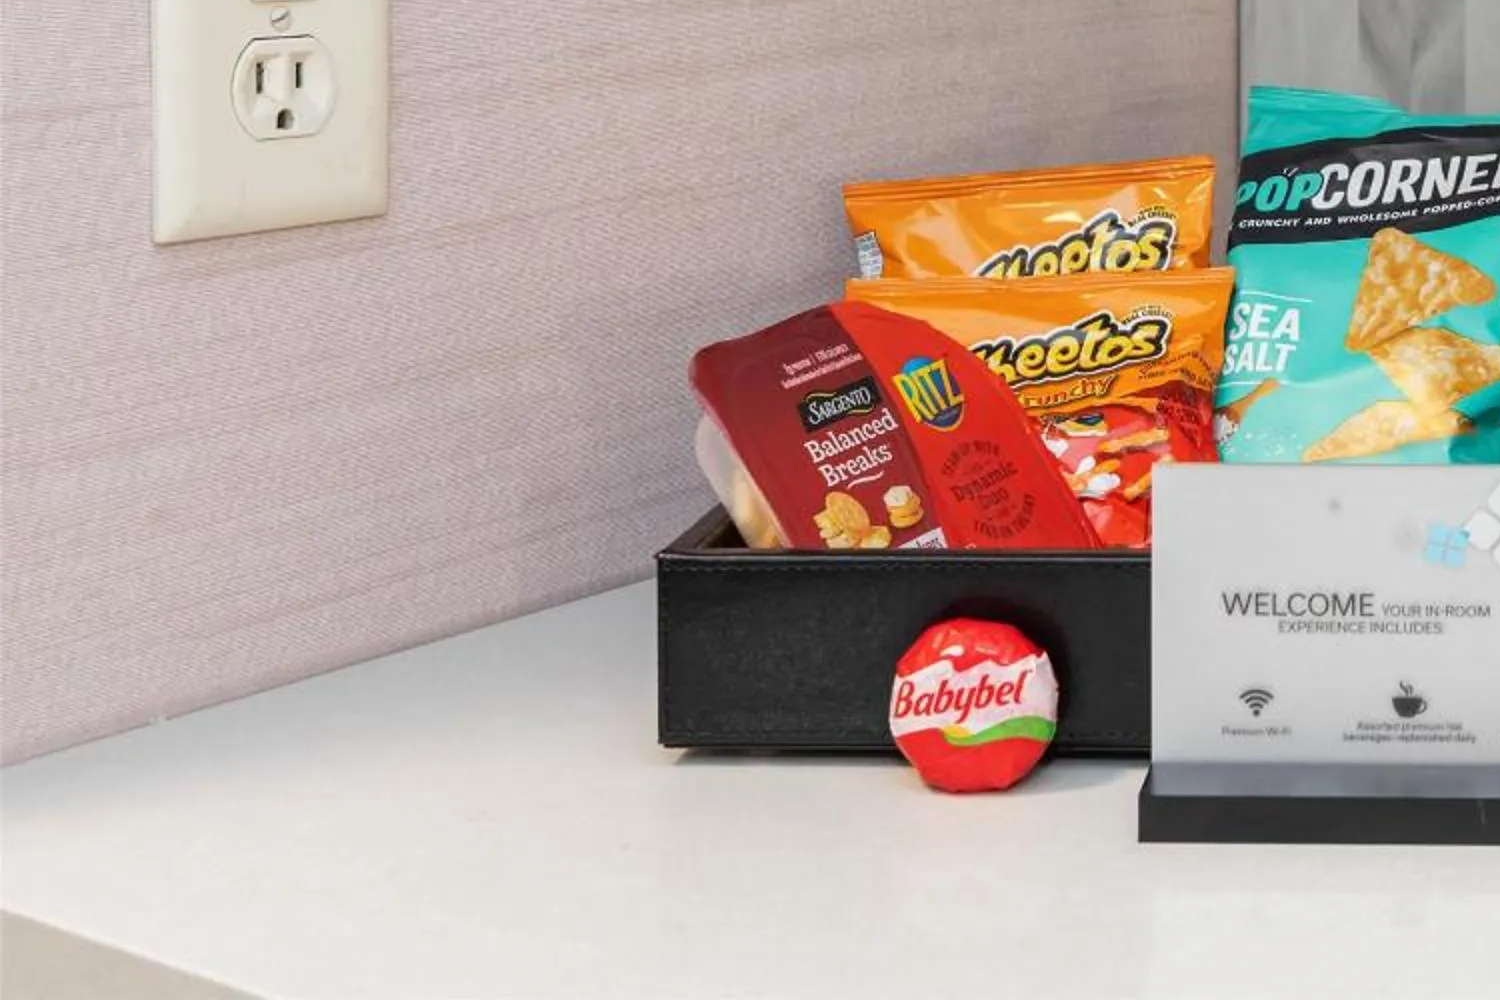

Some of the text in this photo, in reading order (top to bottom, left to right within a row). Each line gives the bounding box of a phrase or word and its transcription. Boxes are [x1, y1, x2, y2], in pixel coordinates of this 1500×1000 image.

[1239, 218, 1300, 229] CRUNCHY
[1304, 217, 1331, 226] AND
[1337, 209, 1417, 224] WHOLESOME
[973, 210, 1175, 277] heetos
[1229, 302, 1301, 341] SEA
[970, 312, 1170, 385] heetos
[1222, 341, 1297, 376] SALT
[808, 386, 872, 425] SARGENTO
[892, 358, 965, 424] RITZ
[1017, 373, 1118, 407] runchy
[804, 407, 899, 463] Balanced
[818, 444, 894, 487] Breaks
[949, 460, 1019, 503] Dynamic
[1222, 592, 1491, 617] WELCOME YOUR IN-ROOM
[1278, 620, 1366, 634] EXPERIENCE
[893, 669, 1029, 725] Babybel
